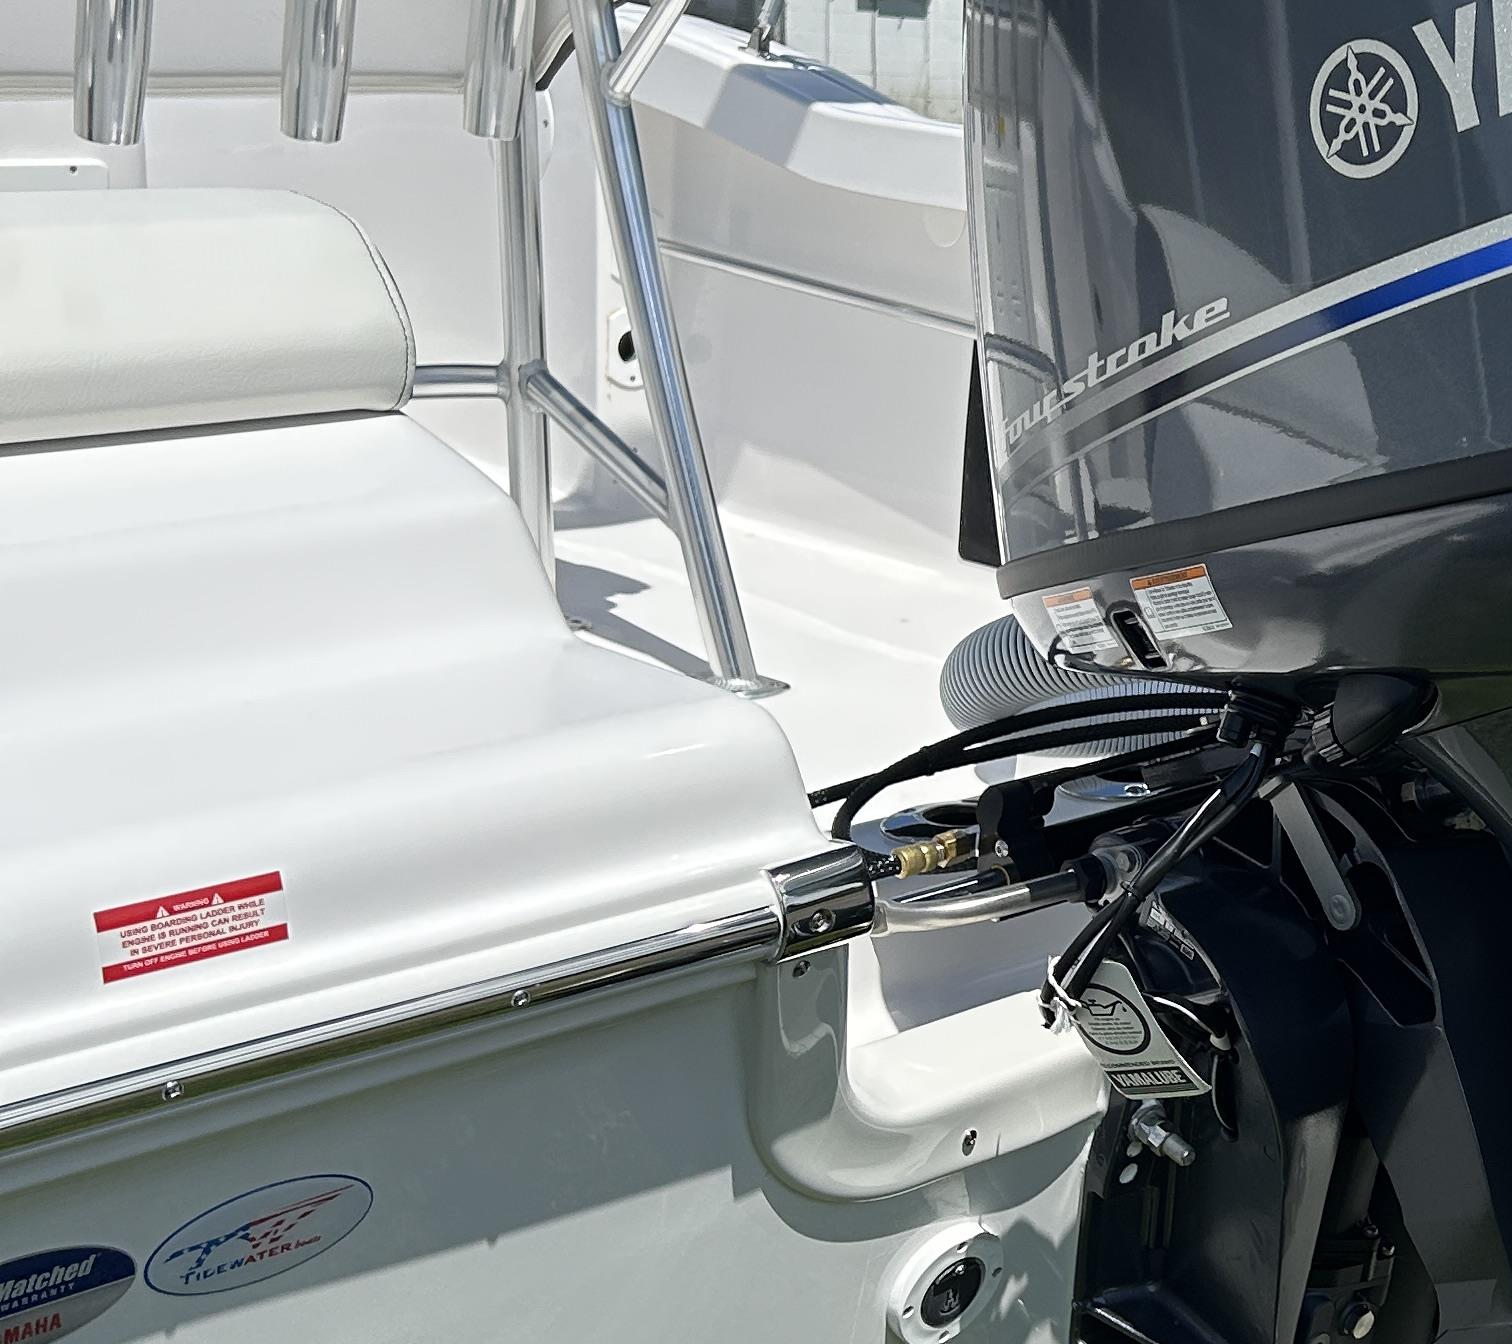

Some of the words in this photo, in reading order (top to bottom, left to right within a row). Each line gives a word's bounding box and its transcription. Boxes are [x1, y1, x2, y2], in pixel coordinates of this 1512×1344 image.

[120, 925, 149, 938] USING
[150, 914, 198, 932] BOARDING
[199, 905, 236, 920] LADDER
[237, 898, 265, 911] WHILE
[172, 897, 210, 912] WARNING
[122, 935, 156, 949] ENGINE
[157, 931, 167, 940] IS
[168, 922, 209, 937] RUNNING
[211, 917, 230, 928] CAN
[231, 908, 266, 922] RESULT
[130, 948, 140, 957] IN
[141, 940, 177, 954] SEVERE
[179, 929, 227, 945] PERSONAL
[228, 919, 261, 933] INJURY
[123, 960, 144, 972] TURN
[144, 957, 159, 967] OFF
[159, 950, 188, 963] ENGINE
[188, 943, 217, 956] BEFORE
[218, 938, 240, 950] USING
[240, 930, 270, 943] LADDER
[1111, 1069, 1187, 1088] YAMALUBE
[0, 1253, 98, 1303] Matched
[179, 1243, 297, 1285] TIDEWATER
